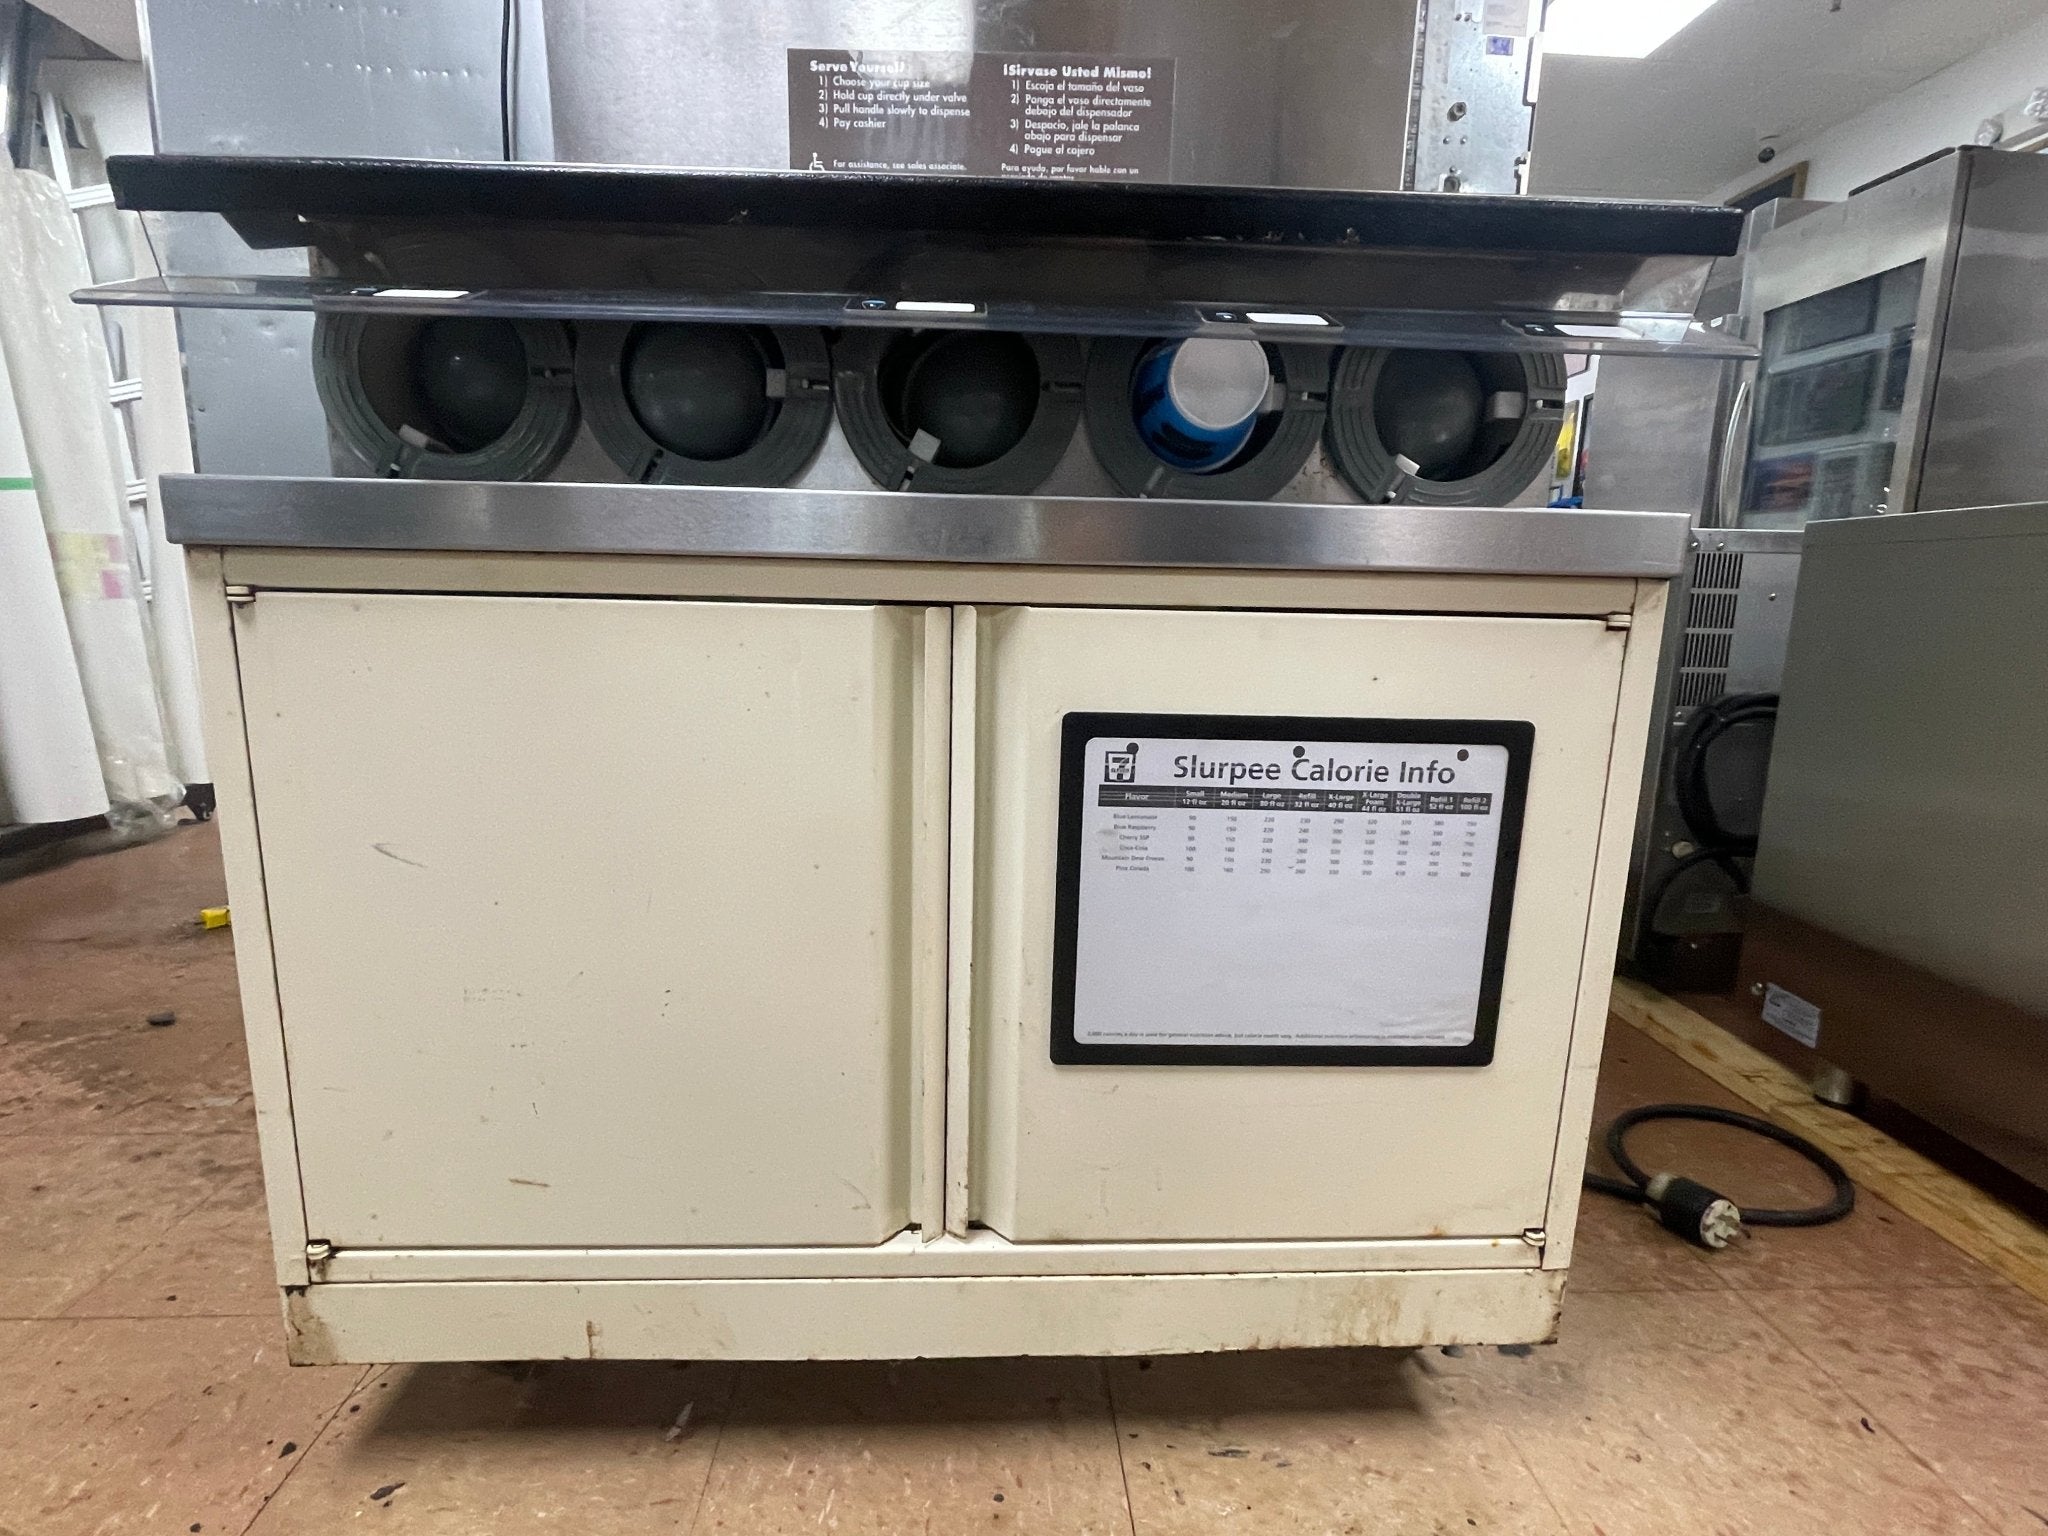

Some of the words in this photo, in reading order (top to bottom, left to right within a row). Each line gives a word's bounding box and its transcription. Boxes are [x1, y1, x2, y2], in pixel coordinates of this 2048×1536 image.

[809, 60, 848, 72] Serve
[1061, 66, 1100, 78] Usted
[1103, 66, 1152, 79] Mismo!
[818, 75, 828, 88] 1)
[832, 76, 867, 87] Choose
[868, 79, 891, 90] your
[893, 79, 910, 90] cup
[912, 79, 930, 89] size
[1011, 80, 1020, 91] 1)
[1025, 80, 1055, 93] Escoja
[1057, 80, 1065, 91] el
[1068, 81, 1104, 92] tamaño
[1105, 80, 1120, 92] del
[1123, 84, 1145, 93] vaso
[818, 89, 828, 101] 2)
[833, 90, 855, 101] Hold
[857, 92, 874, 103] cup
[876, 91, 911, 103] directly
[913, 92, 940, 102] under
[943, 92, 968, 103] valve
[1010, 94, 1020, 105] 2)
[1025, 94, 1055, 106] Ponga
[1057, 94, 1065, 104] el
[1068, 97, 1090, 106] vaso
[1092, 95, 1152, 107] directamente
[818, 104, 829, 115] 3)
[833, 104, 851, 114] Pull
[853, 104, 884, 115] handle
[886, 104, 916, 118] slowly
[918, 106, 928, 116] to
[930, 105, 971, 118] dispense
[1025, 106, 1057, 118] debajo
[1059, 106, 1074, 116] del
[1076, 107, 1133, 120] dispensador
[818, 117, 829, 129] 4)
[833, 118, 851, 130] Pay
[853, 118, 887, 129] cashier
[1010, 119, 1019, 131] 3)
[1024, 119, 1069, 132] Despacio,
[1071, 120, 1089, 132] jale
[1091, 120, 1100, 131] la
[1103, 121, 1140, 133] palanca
[1024, 131, 1051, 143] abajo
[1054, 133, 1076, 144] para
[1078, 131, 1123, 144] dispensar
[1009, 144, 1019, 155] 4)
[1023, 143, 1053, 157] Pague
[1055, 143, 1064, 154] al
[1066, 145, 1095, 157] cajero
[833, 160, 846, 168] For
[907, 161, 927, 170] sales
[1001, 162, 1020, 172] Para
[1021, 163, 1049, 175] ayuda,
[1051, 165, 1065, 175] por
[1066, 163, 1088, 174] favor
[1089, 164, 1111, 174] hable
[1173, 755, 1281, 785] Slurpee
[1291, 757, 1390, 782] Calorie
[1399, 759, 1456, 784] Info
[1262, 792, 1282, 800] Large
[1328, 794, 1355, 802] X-Large
